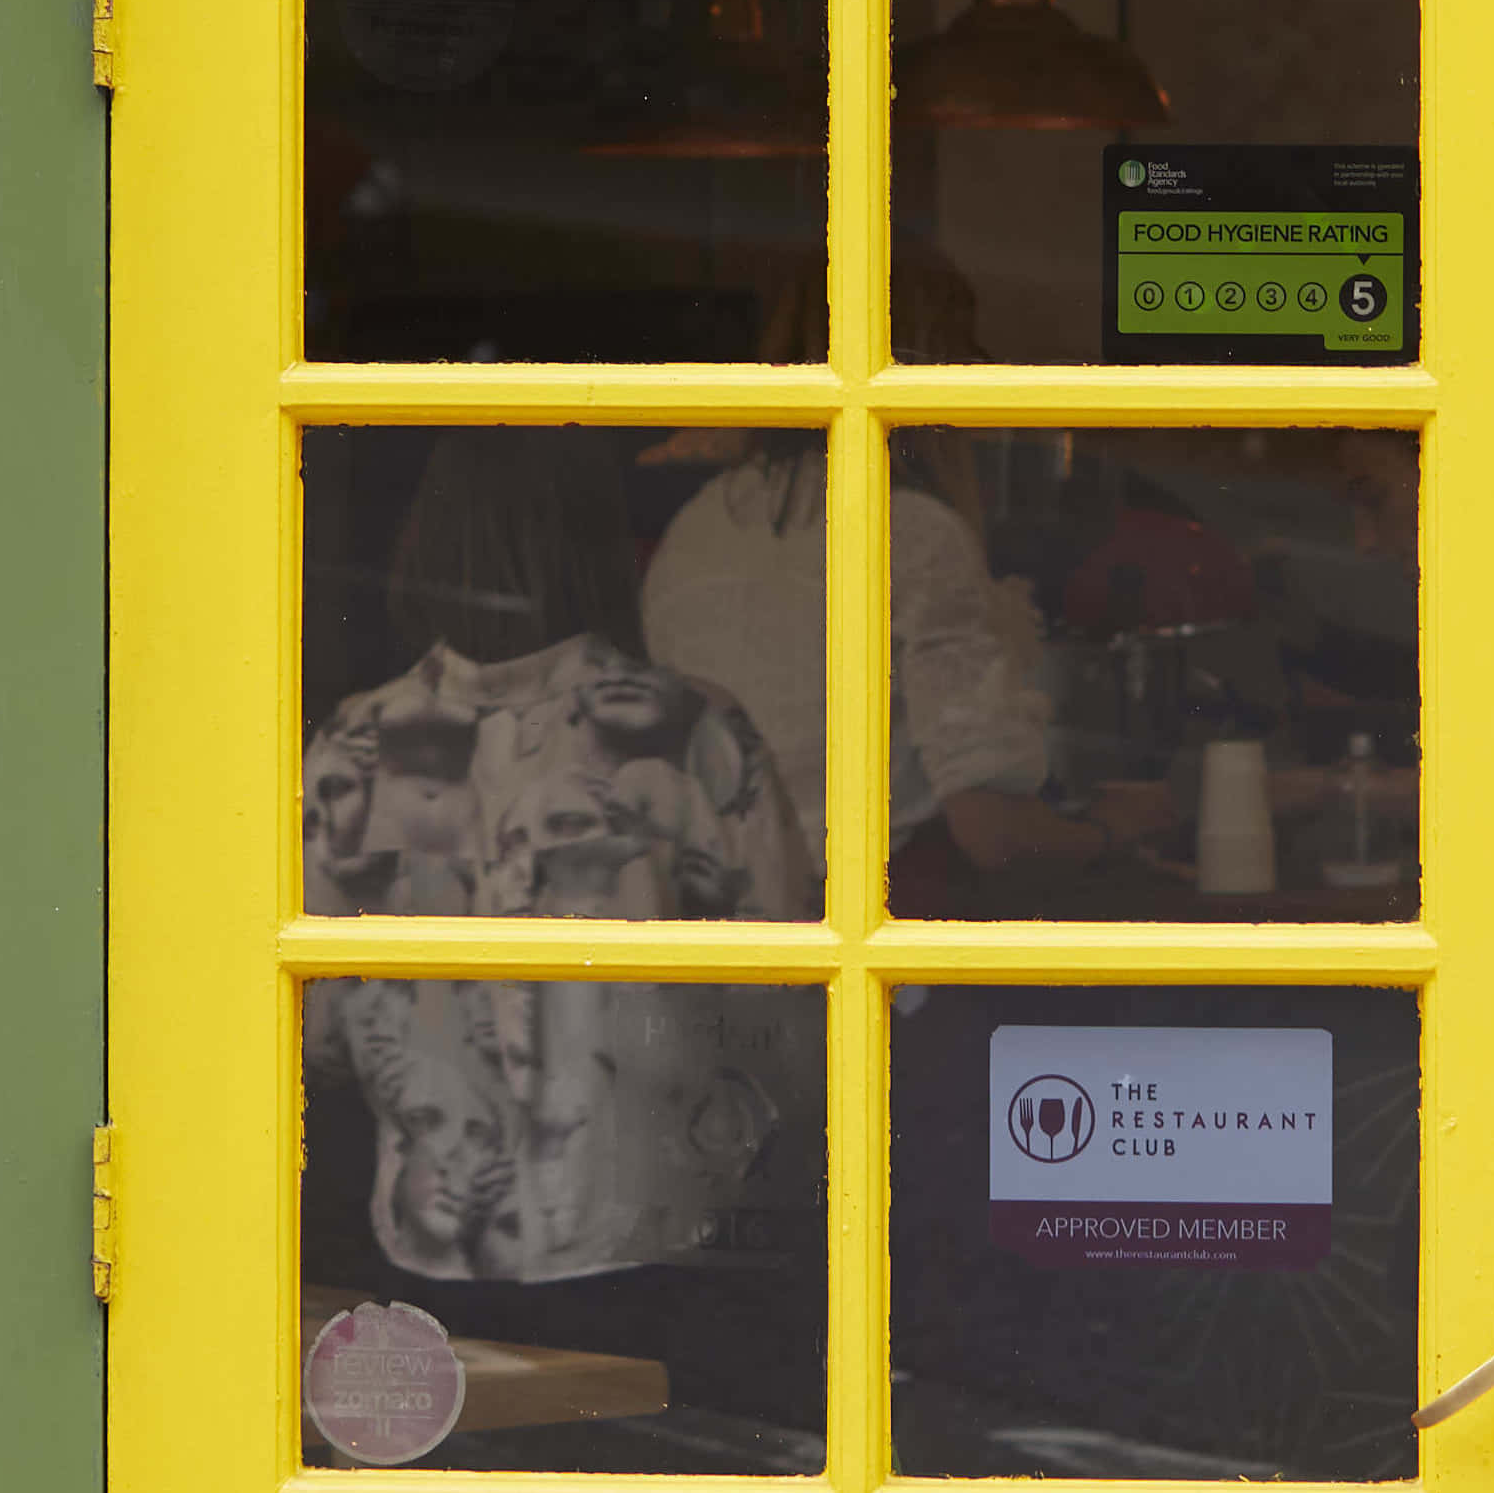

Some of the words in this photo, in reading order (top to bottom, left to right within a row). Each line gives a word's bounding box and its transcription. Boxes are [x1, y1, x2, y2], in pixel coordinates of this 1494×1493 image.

[1148, 162, 1169, 170] Food
[1134, 224, 1202, 243] FOOD
[1208, 224, 1303, 244] HYGIENE
[1309, 224, 1389, 244] RATING
[1143, 288, 1156, 305] 0
[1185, 288, 1194, 305] 1
[1224, 288, 1237, 305] 2
[1265, 288, 1278, 306] 3
[1305, 288, 1319, 306] 4
[1351, 281, 1376, 317] 5
[1111, 1083, 1158, 1102] THE
[1111, 1111, 1317, 1131] RESTAURANT
[1112, 1138, 1176, 1157] CLUB
[1035, 1217, 1171, 1241] APPROVED
[1178, 1218, 1288, 1241] MEMBER
[332, 1354, 435, 1378] review
